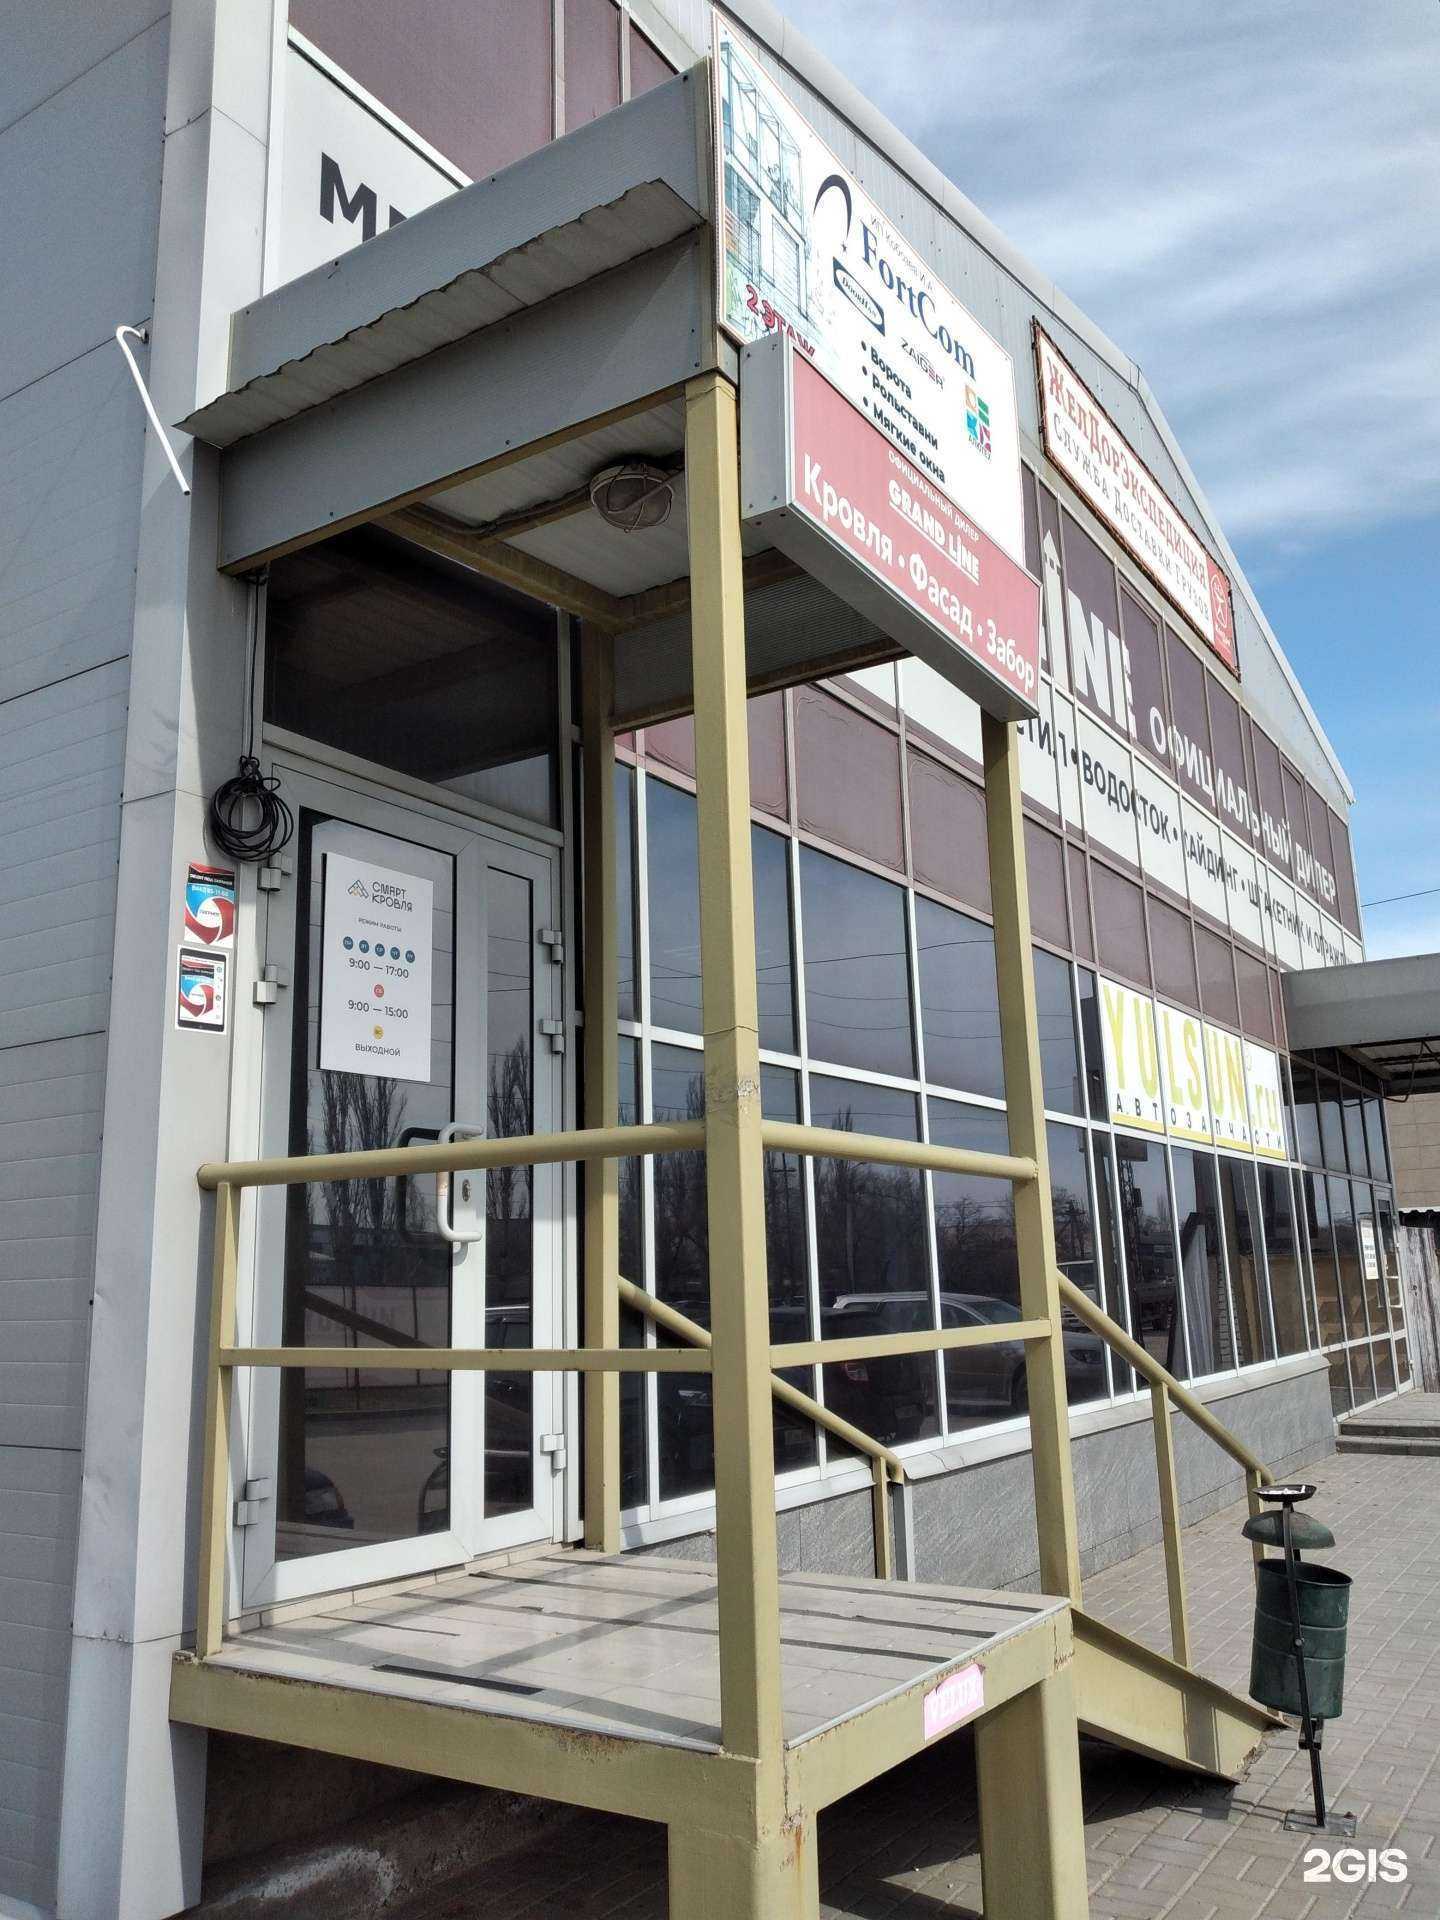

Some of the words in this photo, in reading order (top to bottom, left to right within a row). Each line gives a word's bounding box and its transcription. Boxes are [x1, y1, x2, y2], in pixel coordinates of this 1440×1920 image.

[860, 219, 976, 381] FortCom
[870, 346, 912, 399] Ворота
[900, 337, 943, 389] ZAIGER
[873, 378, 938, 451] Рольставни
[873, 406, 918, 457] Мягкие
[919, 453, 945, 482] окна
[888, 450, 953, 524] ОФИЦИАЛЬНЫЙ
[954, 510, 980, 541] ДИЛЕР
[888, 479, 945, 550] GRAND
[949, 534, 980, 580] LINE
[804, 454, 893, 567] Кровля
[909, 553, 974, 642] Фасад
[987, 619, 1035, 694] Забор
[1082, 751, 1171, 843] ВОДОСТОК
[1181, 824, 1238, 893] САЙДИНГ
[1150, 706, 1292, 864] ОФИЦИАЛЬНЫЙ
[1295, 842, 1337, 905] ДИЛЕР
[372, 881, 407, 899] СМАРТ
[372, 894, 413, 912] КРОВЛЯ
[349, 957, 371, 971] 9:00
[385, 965, 409, 978] 17:00
[348, 999, 370, 1013] 9:00
[385, 1006, 409, 1019] 15:00
[355, 1042, 401, 1056] ВЫХОДНОЙ
[1116, 1093, 1282, 1149] АВТОЗАПЧАСТИ
